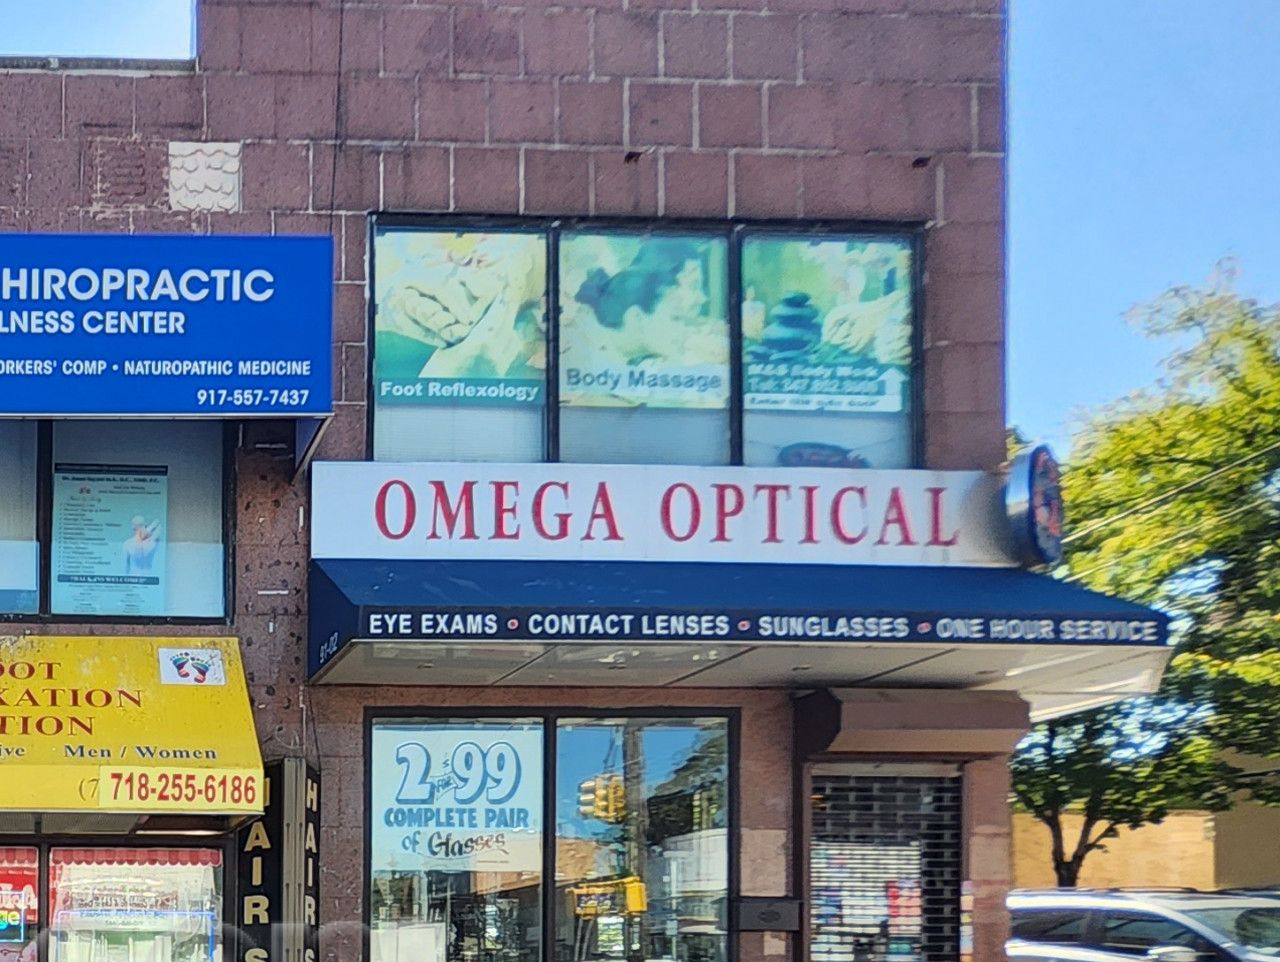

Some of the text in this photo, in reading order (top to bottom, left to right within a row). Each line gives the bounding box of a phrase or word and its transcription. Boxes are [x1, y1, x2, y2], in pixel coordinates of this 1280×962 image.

[83, 311, 185, 335] CENTER
[62, 360, 107, 376] COMP
[124, 360, 233, 376] NATUROPATHIC
[238, 361, 311, 377] MEDICINE
[565, 367, 621, 390] Body
[627, 369, 721, 391] Massage
[197, 389, 309, 407] 917-557-7437
[380, 382, 538, 401] Foot Reflexology
[373, 478, 960, 549] OMEGA OPTICAL
[369, 613, 413, 635] EYE
[420, 613, 499, 635] EXAMS
[527, 614, 637, 636] CONTACT
[641, 614, 730, 637] LENSES
[757, 615, 910, 639] SUNGLASSES
[936, 618, 985, 639] ONE
[1059, 619, 1158, 641] SERVICE
[64, 743, 112, 759] Men
[136, 744, 217, 760] Women
[110, 772, 257, 805] 718-255-6186
[384, 808, 530, 828] COMPLETE PAIR
[303, 778, 319, 927] HAIR
[402, 831, 506, 857] of Glasses
[242, 821, 272, 926] AIR
